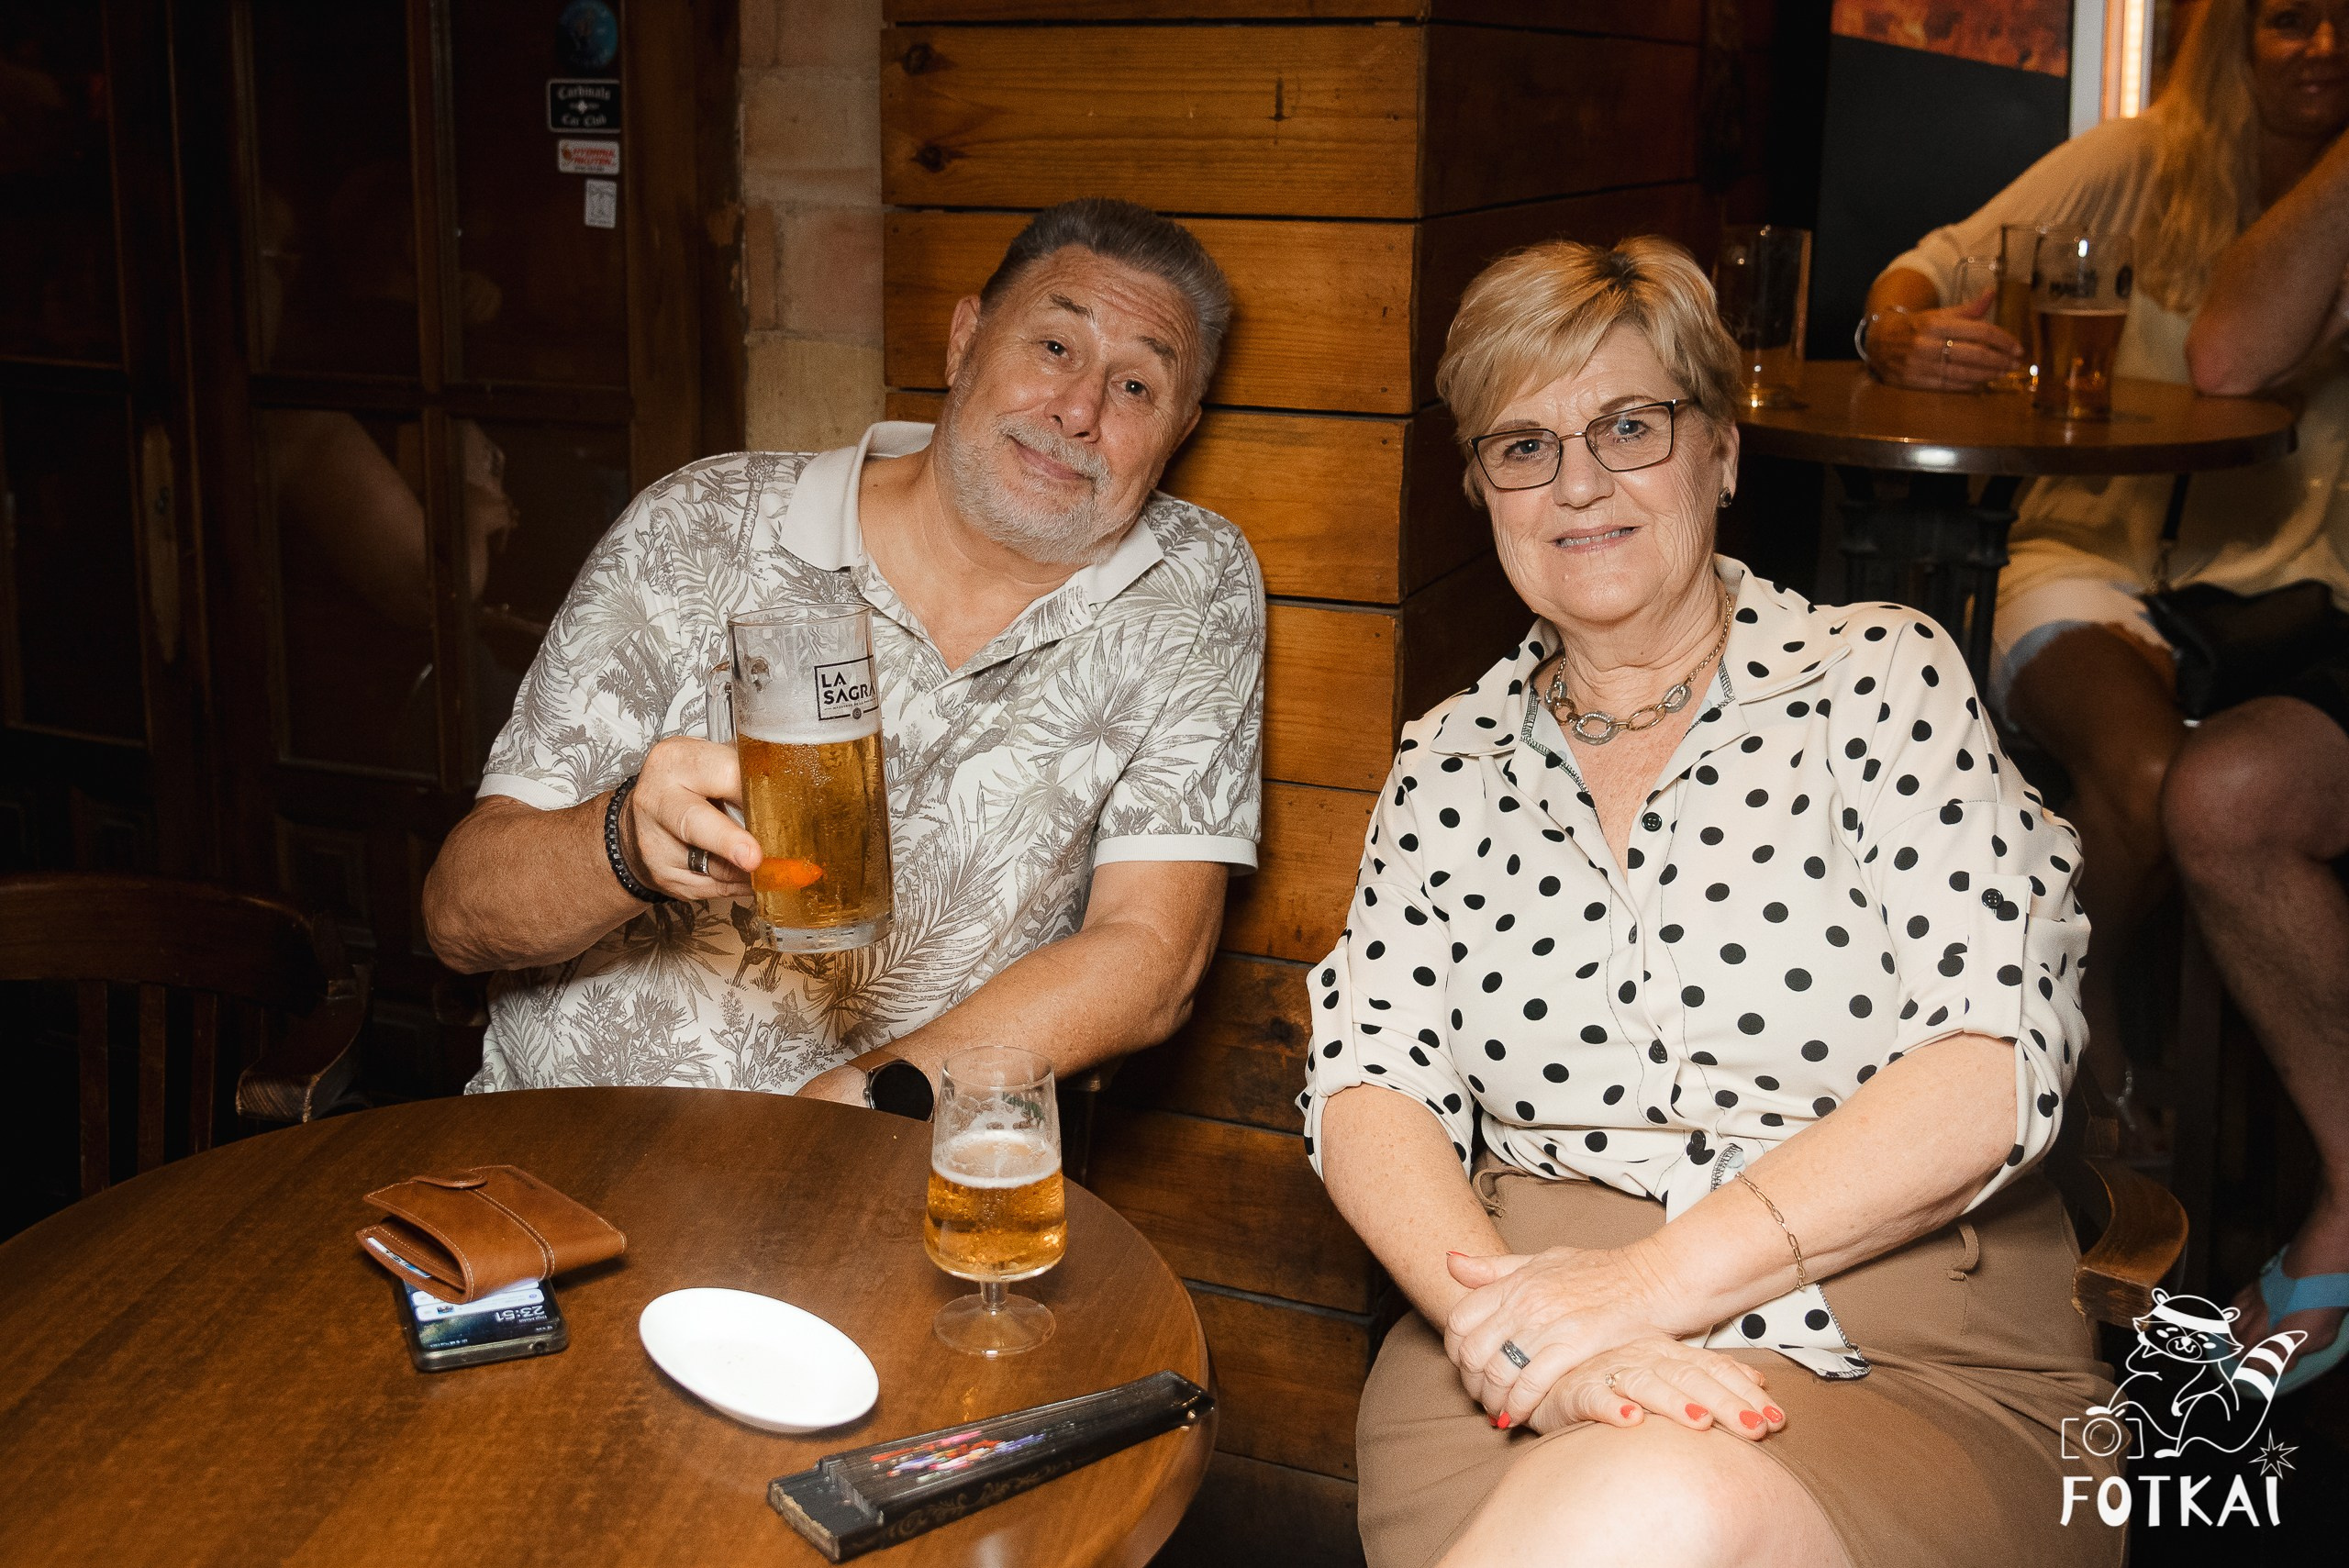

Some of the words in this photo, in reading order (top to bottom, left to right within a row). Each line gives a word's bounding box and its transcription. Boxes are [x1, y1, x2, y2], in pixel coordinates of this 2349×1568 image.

[562, 113, 579, 126] Car
[583, 114, 607, 127] Club
[821, 671, 847, 688] LA
[823, 681, 875, 705] SAGRA
[495, 1306, 545, 1322] 23:51
